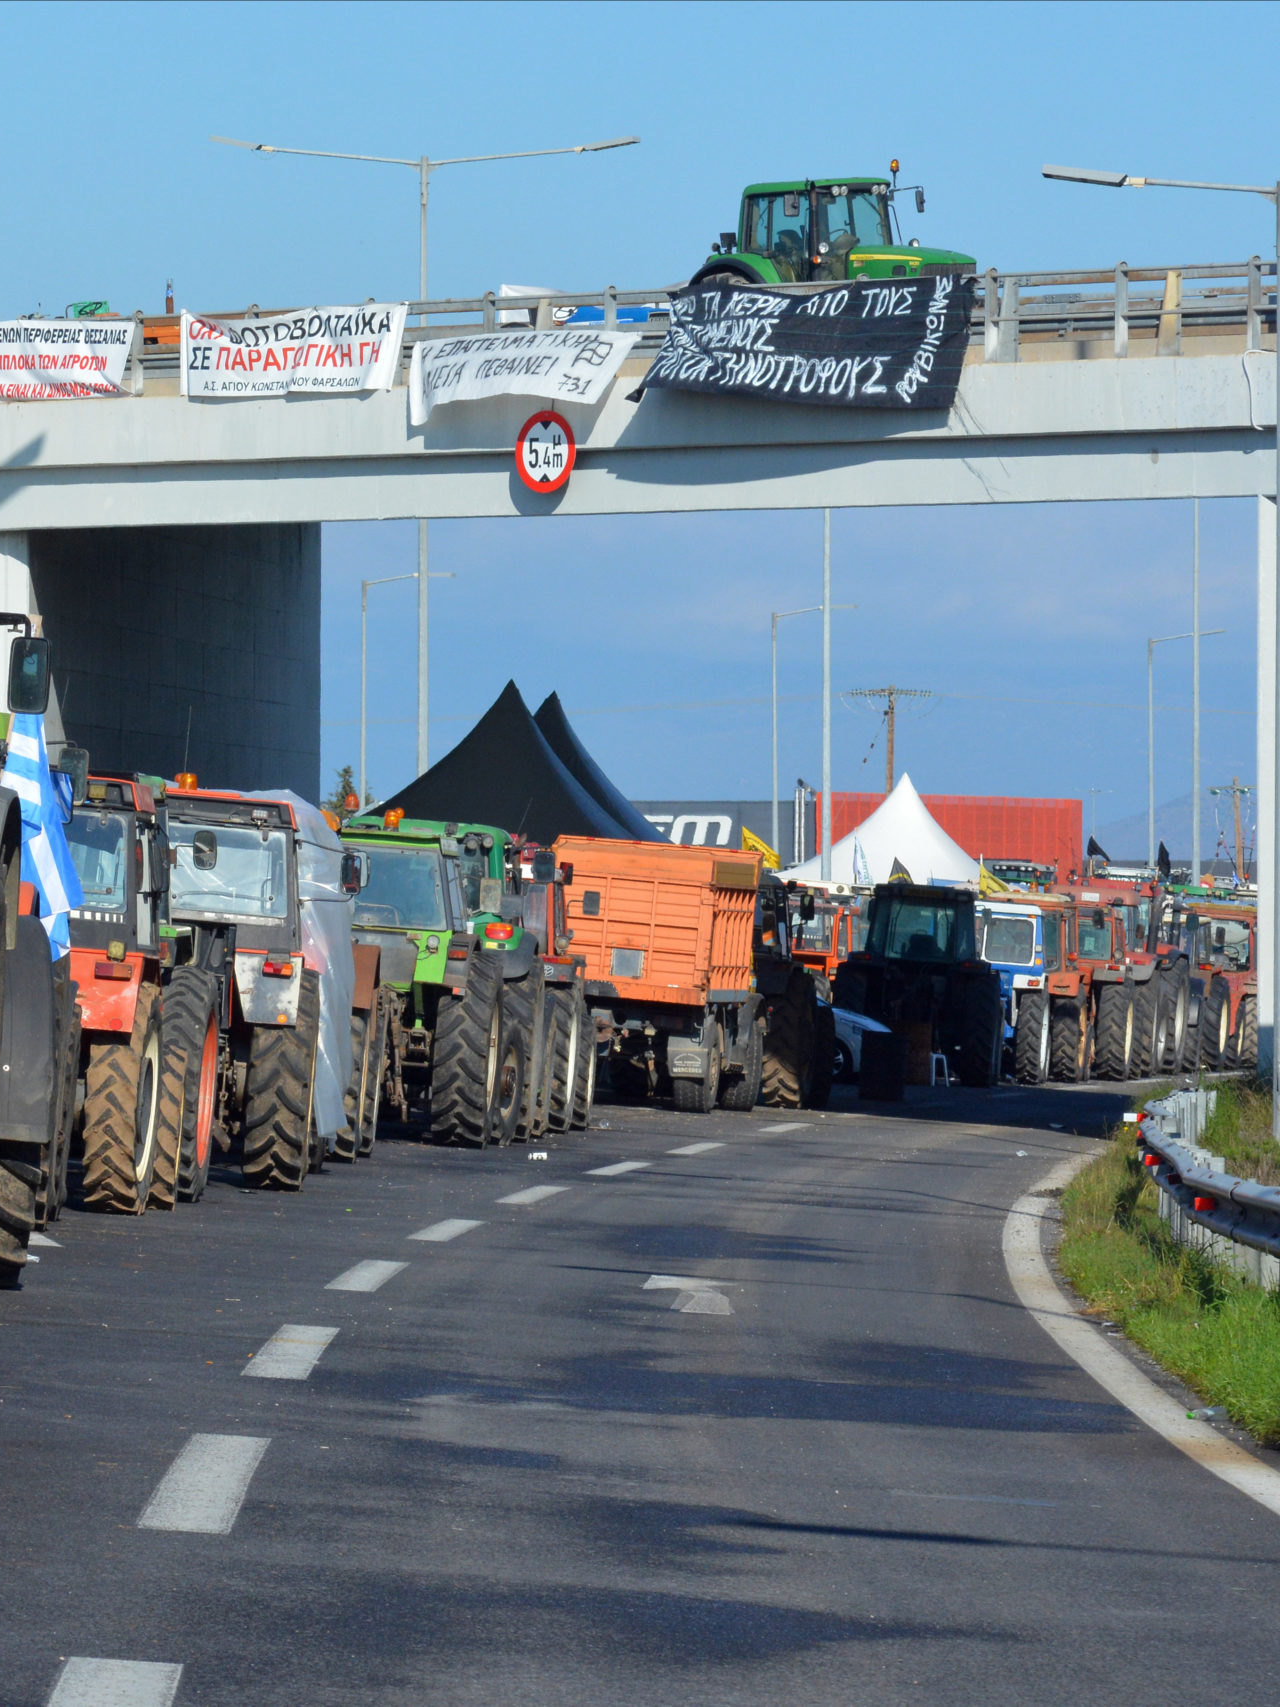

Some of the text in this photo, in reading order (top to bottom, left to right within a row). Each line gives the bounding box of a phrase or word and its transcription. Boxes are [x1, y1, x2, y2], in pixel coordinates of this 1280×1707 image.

[861, 287, 917, 318] ΤΟΥΣ
[22, 328, 83, 344] ΠΕΡΙΦΕΡΕΙΑΣ
[84, 329, 128, 344] ΘΕΣΣΑΛΙΑΣ
[38, 354, 60, 370] ΤΩΝ
[60, 354, 108, 372] ΑΓΡΟΤΩΝ
[189, 340, 382, 372] ΣΕ ΠΑΡΑΓΩΓΙΚΗ ΓΗ
[6, 384, 31, 398] ΕΙΝΑΙ
[31, 383, 47, 398] ΚΑΙ
[203, 380, 219, 391] Α.Σ.
[221, 381, 250, 392] ΑΓΙΟΥ
[311, 376, 361, 387] ΦΑΡΣΑΛΩΝ
[558, 373, 592, 395] 731
[528, 437, 551, 469] 5.4
